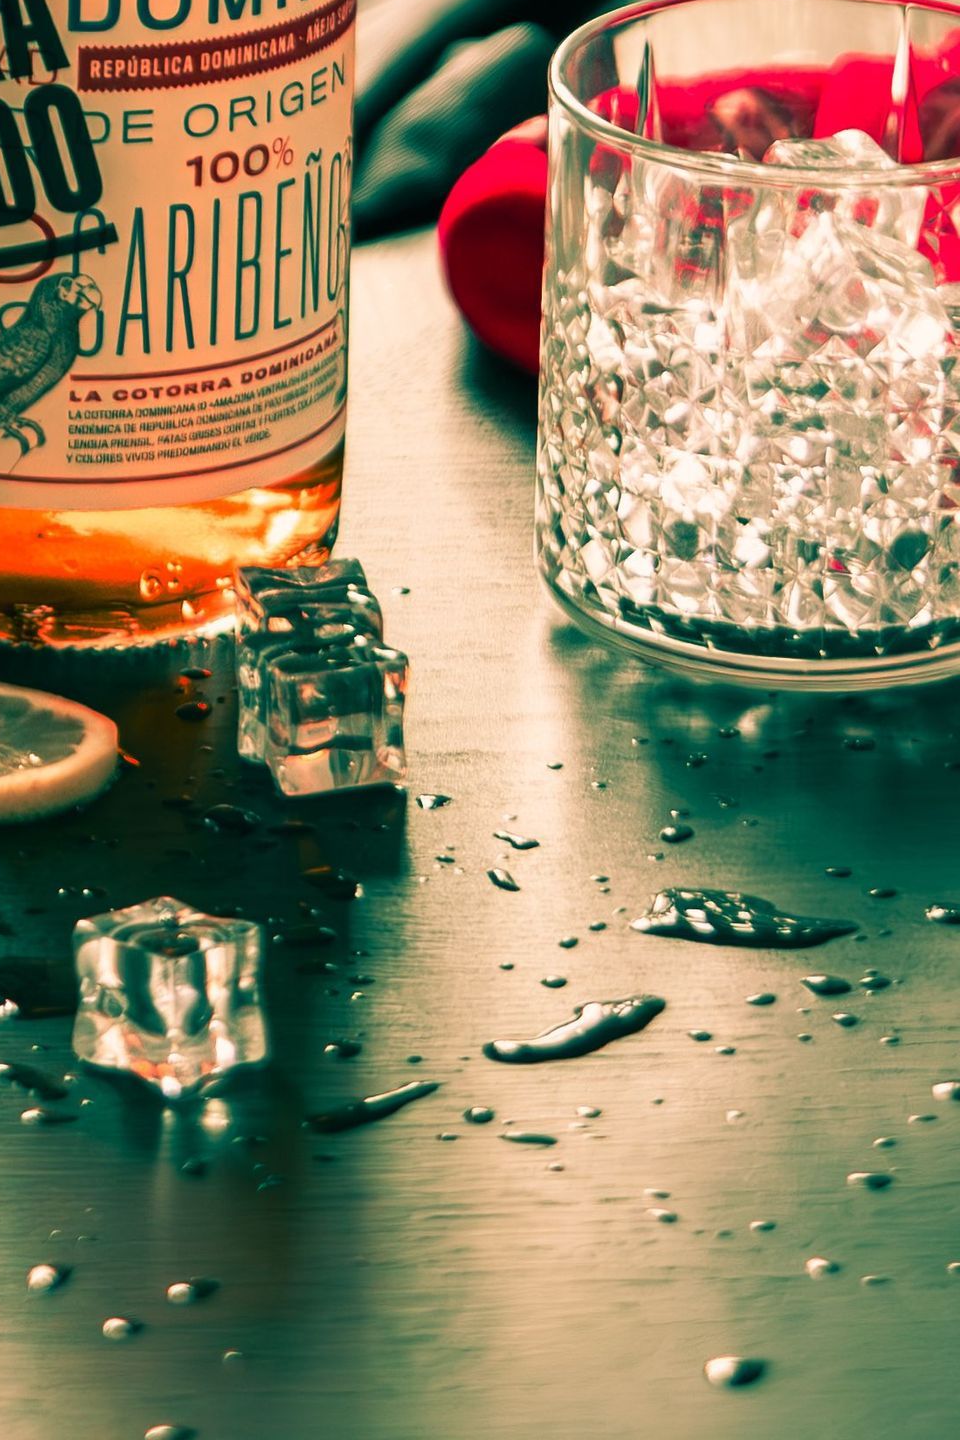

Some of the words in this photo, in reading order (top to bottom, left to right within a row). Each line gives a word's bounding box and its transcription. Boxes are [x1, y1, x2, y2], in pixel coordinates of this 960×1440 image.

[90, 55, 193, 78] REPÚBLICA
[201, 31, 295, 71] DOMINICANA
[183, 54, 346, 138] ORIGEN
[186, 135, 295, 187] 100%
[69, 389, 102, 402] LA
[112, 377, 232, 401] COTORRA
[241, 330, 337, 385] DOMINICANA
[68, 409, 82, 420] LA
